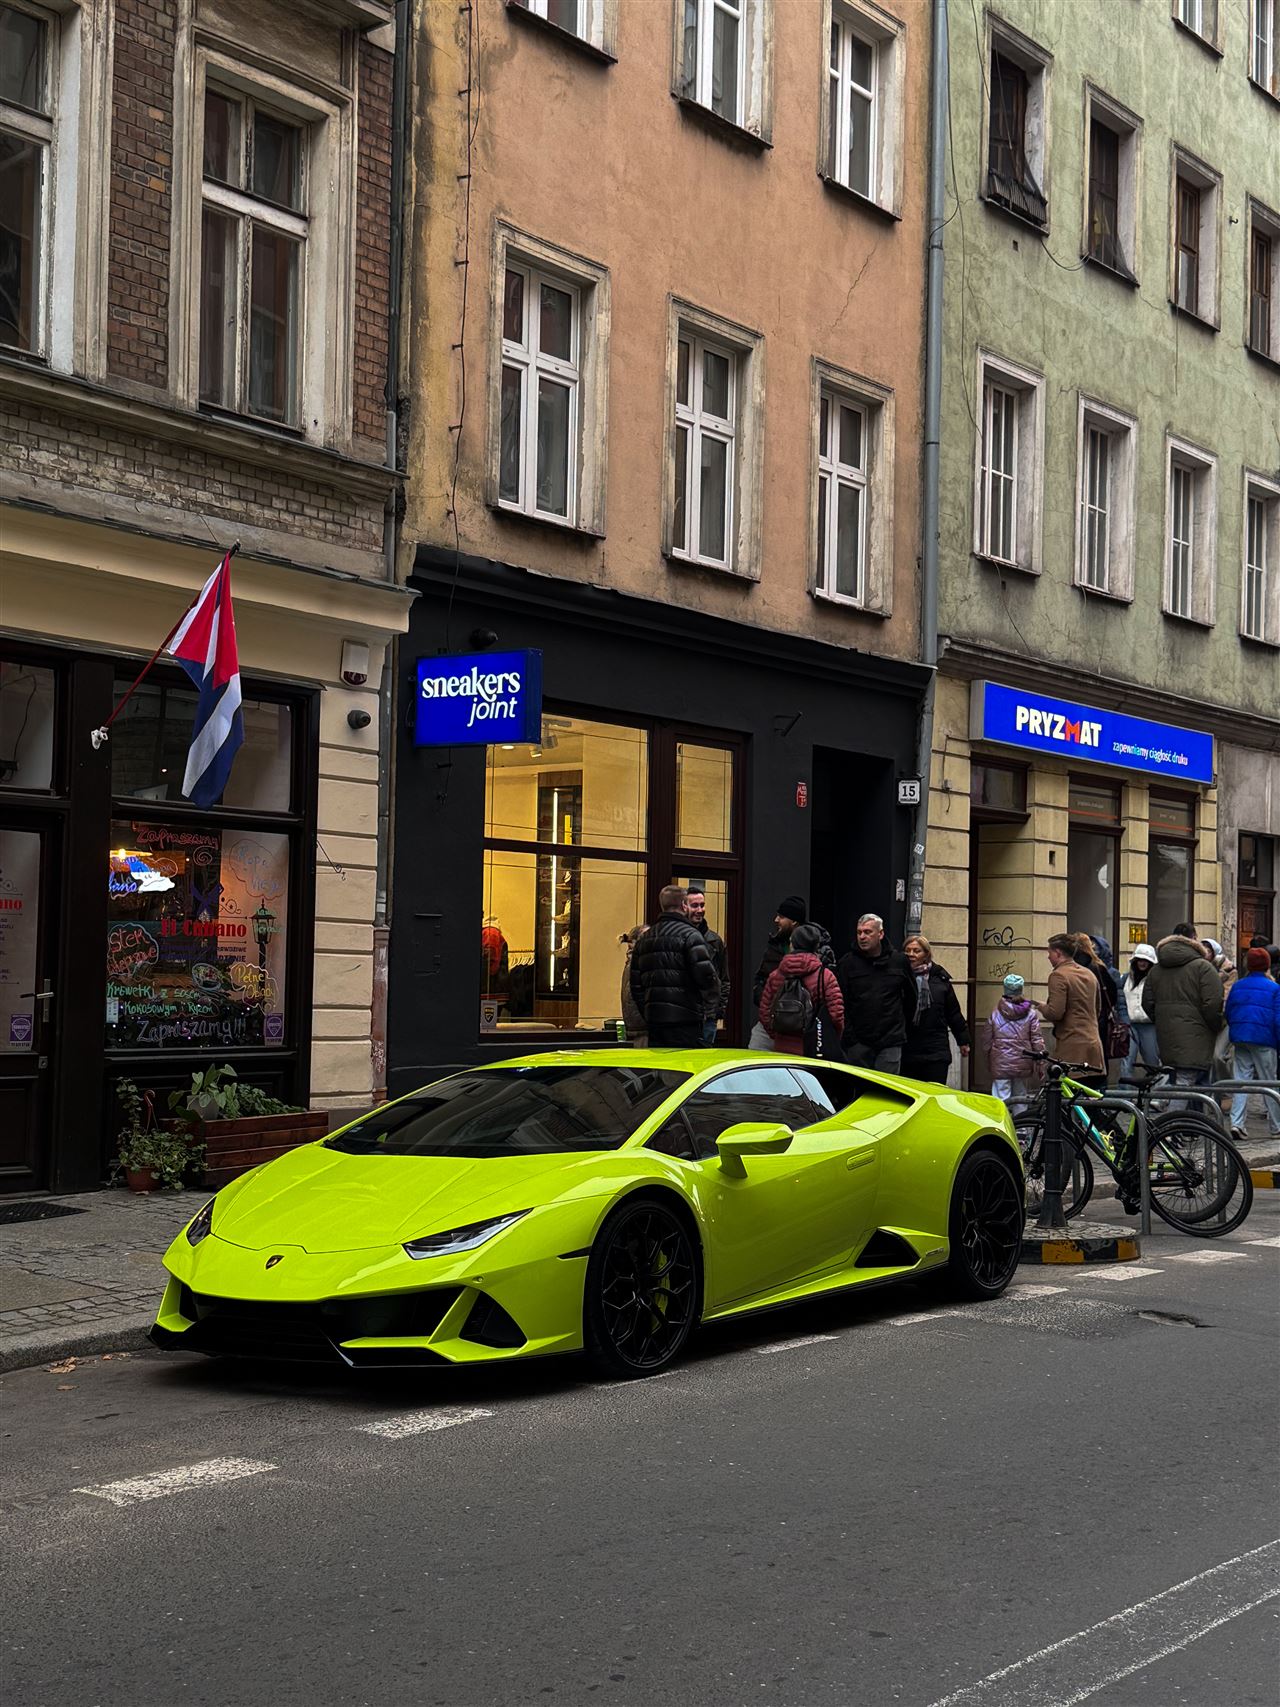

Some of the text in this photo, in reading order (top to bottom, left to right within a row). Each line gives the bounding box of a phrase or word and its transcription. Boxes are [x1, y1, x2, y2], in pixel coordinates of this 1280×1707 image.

[421, 666, 521, 701] sneakers
[466, 696, 517, 728] joint
[1016, 705, 1102, 747] PRYZMAT
[1112, 741, 1148, 760] zapewniamy
[1171, 751, 1188, 766] druku
[902, 785, 916, 797] 15
